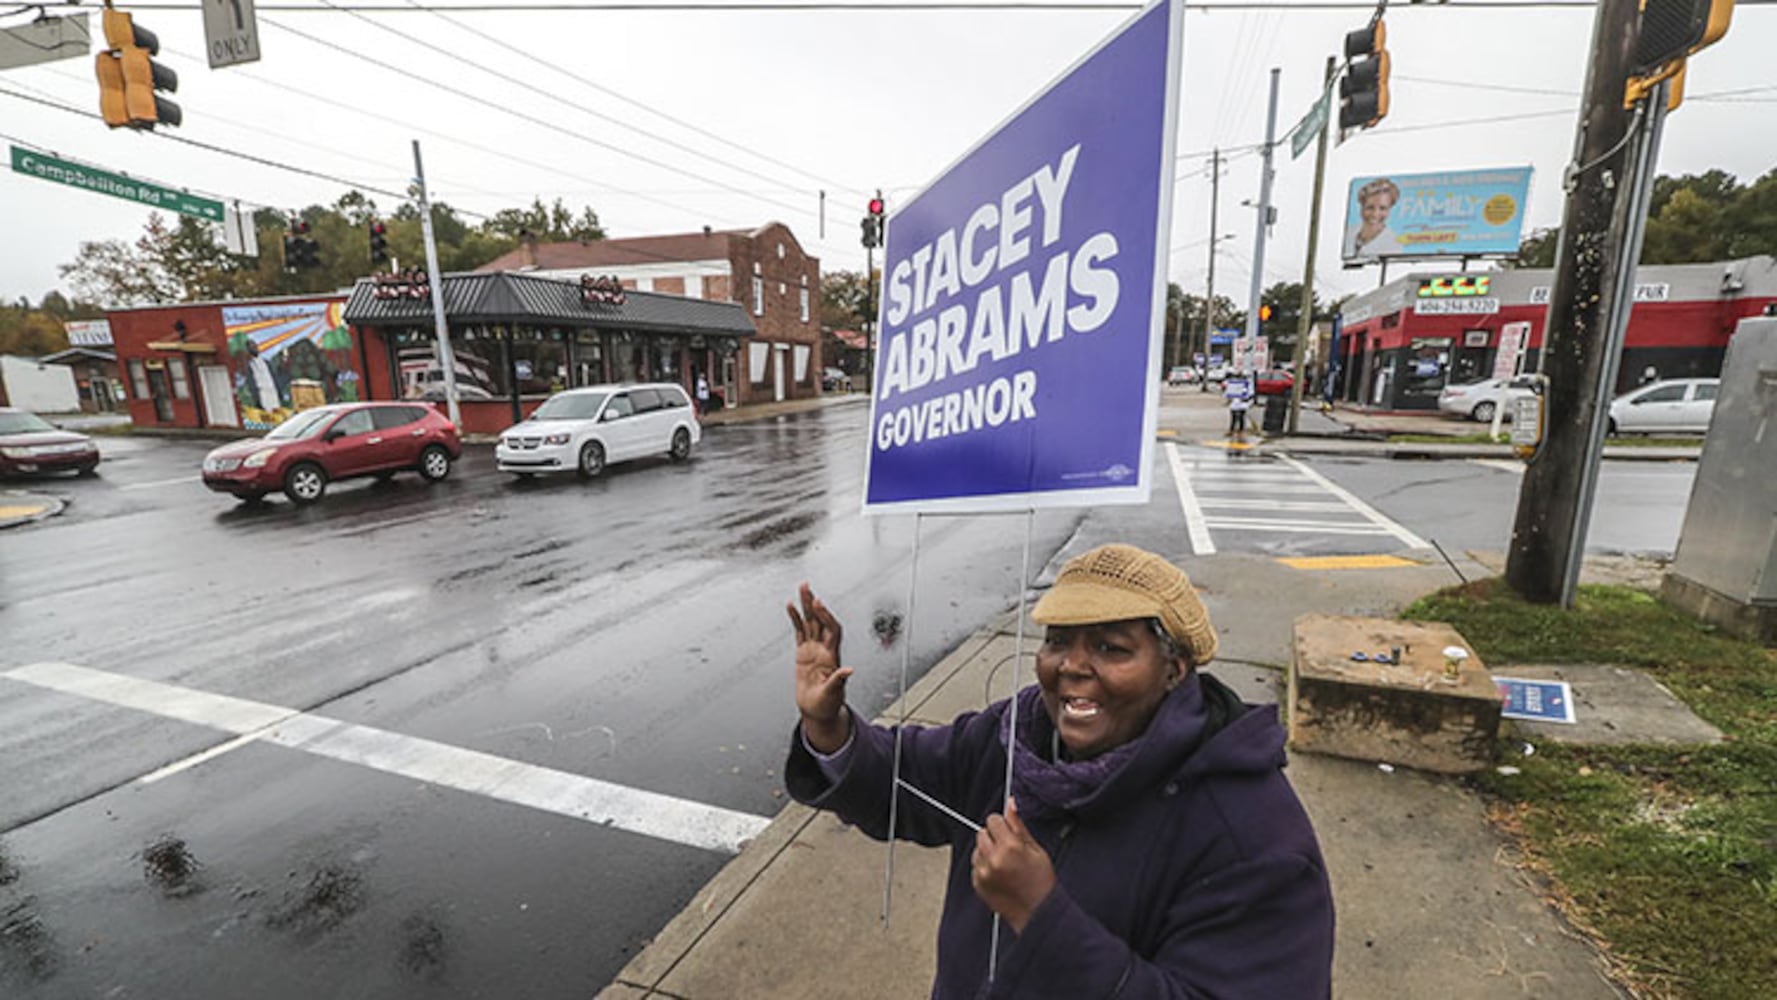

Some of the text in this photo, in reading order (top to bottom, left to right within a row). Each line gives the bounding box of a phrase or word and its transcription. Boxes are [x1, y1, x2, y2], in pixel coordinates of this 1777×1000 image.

[213, 35, 250, 60] ONLY
[20, 155, 136, 199] Campbellton
[138, 186, 160, 204] Rd
[1399, 193, 1478, 218] FAMILY
[887, 143, 1081, 327] STACEY
[880, 232, 1119, 401] ABRAMS
[877, 370, 1037, 451] GOVERNOR
